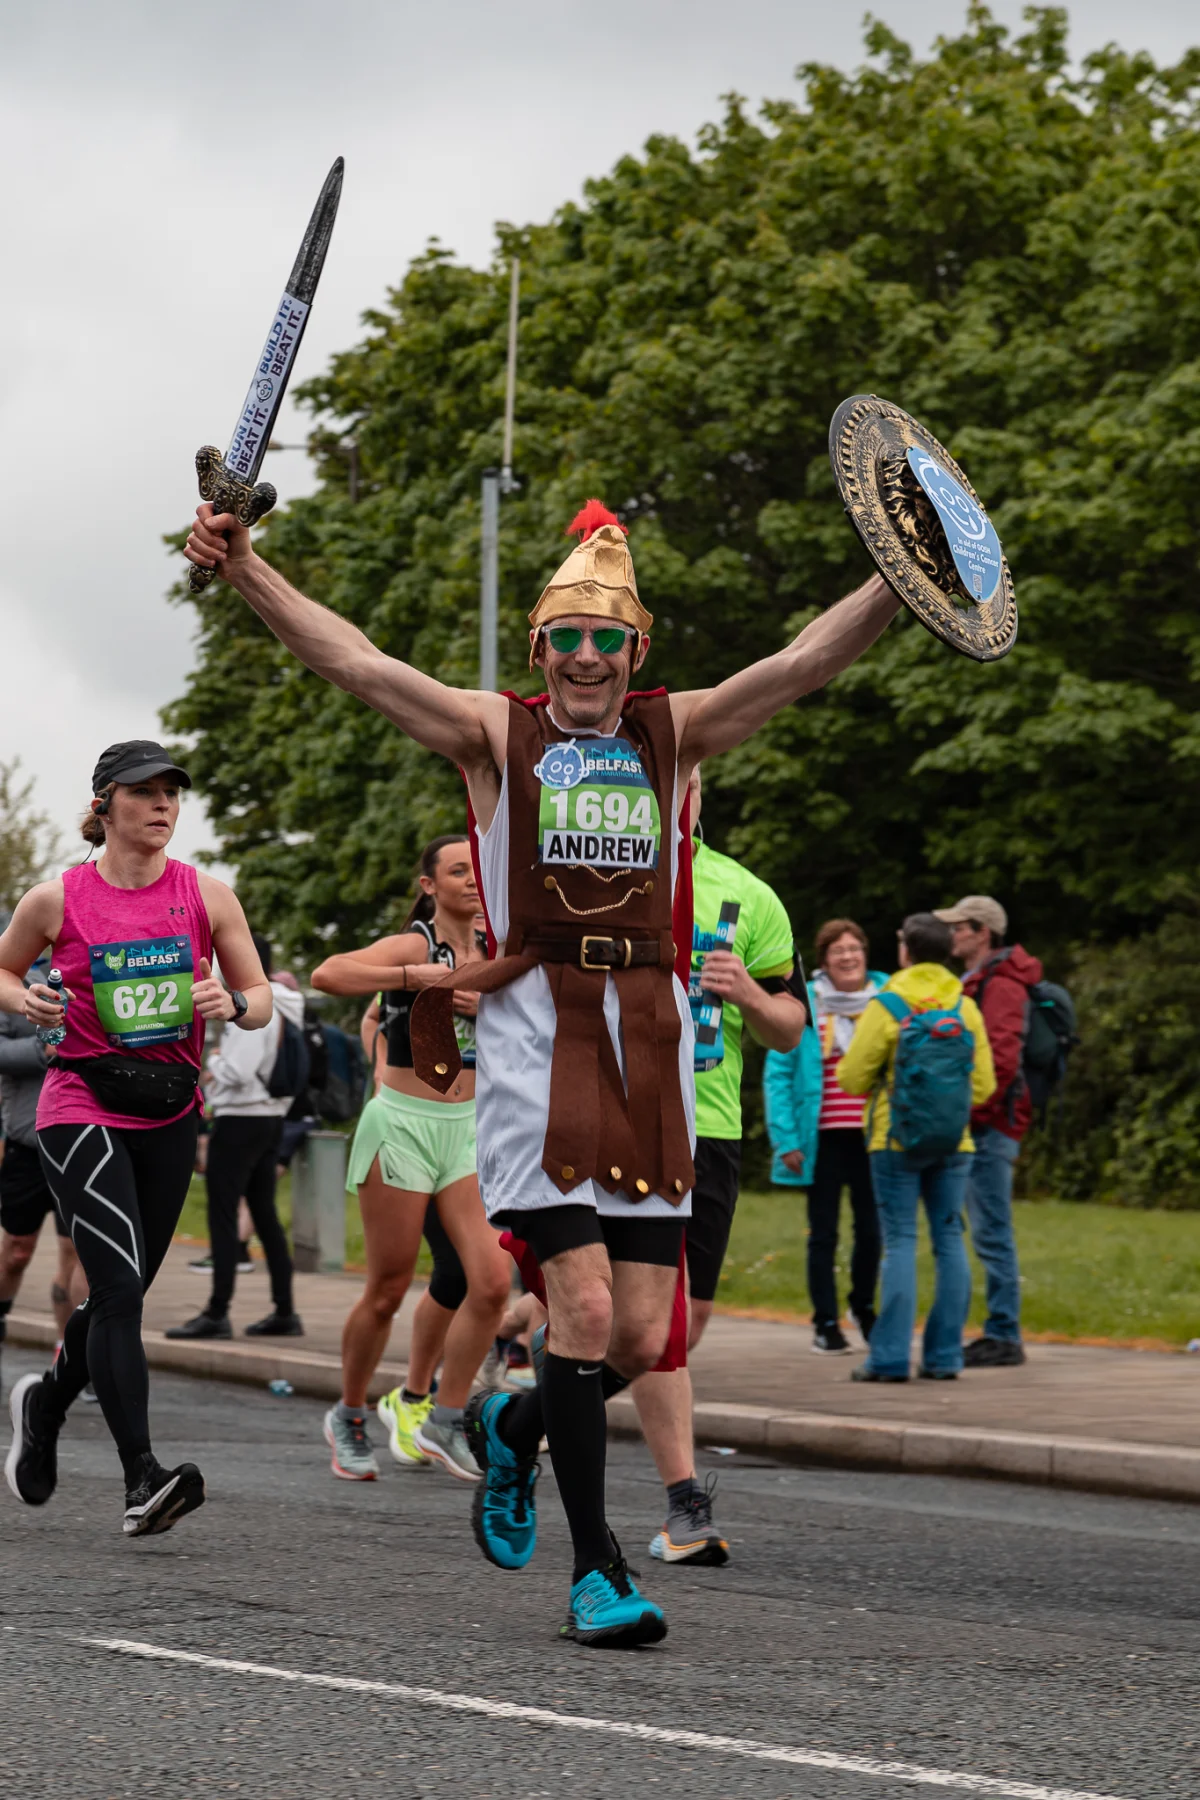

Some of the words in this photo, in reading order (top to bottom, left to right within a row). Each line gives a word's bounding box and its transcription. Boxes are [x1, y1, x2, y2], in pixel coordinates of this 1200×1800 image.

[259, 321, 283, 375] BUILD
[270, 329, 294, 377] BEAT
[287, 310, 302, 329] IT.
[227, 425, 248, 465] RUN
[235, 426, 260, 475] BEAT
[252, 407, 269, 427] IT.
[952, 543, 980, 561] Children's
[968, 560, 986, 574] Centre
[586, 758, 642, 774] BELFAST
[601, 770, 634, 779] MARATHON
[549, 790, 653, 835] 1694
[547, 834, 652, 864] ANDREW
[127, 953, 180, 968] BELFAST
[141, 964, 169, 972] MARATHON
[113, 981, 180, 1019] 622
[135, 1022, 165, 1030] MARATHON
